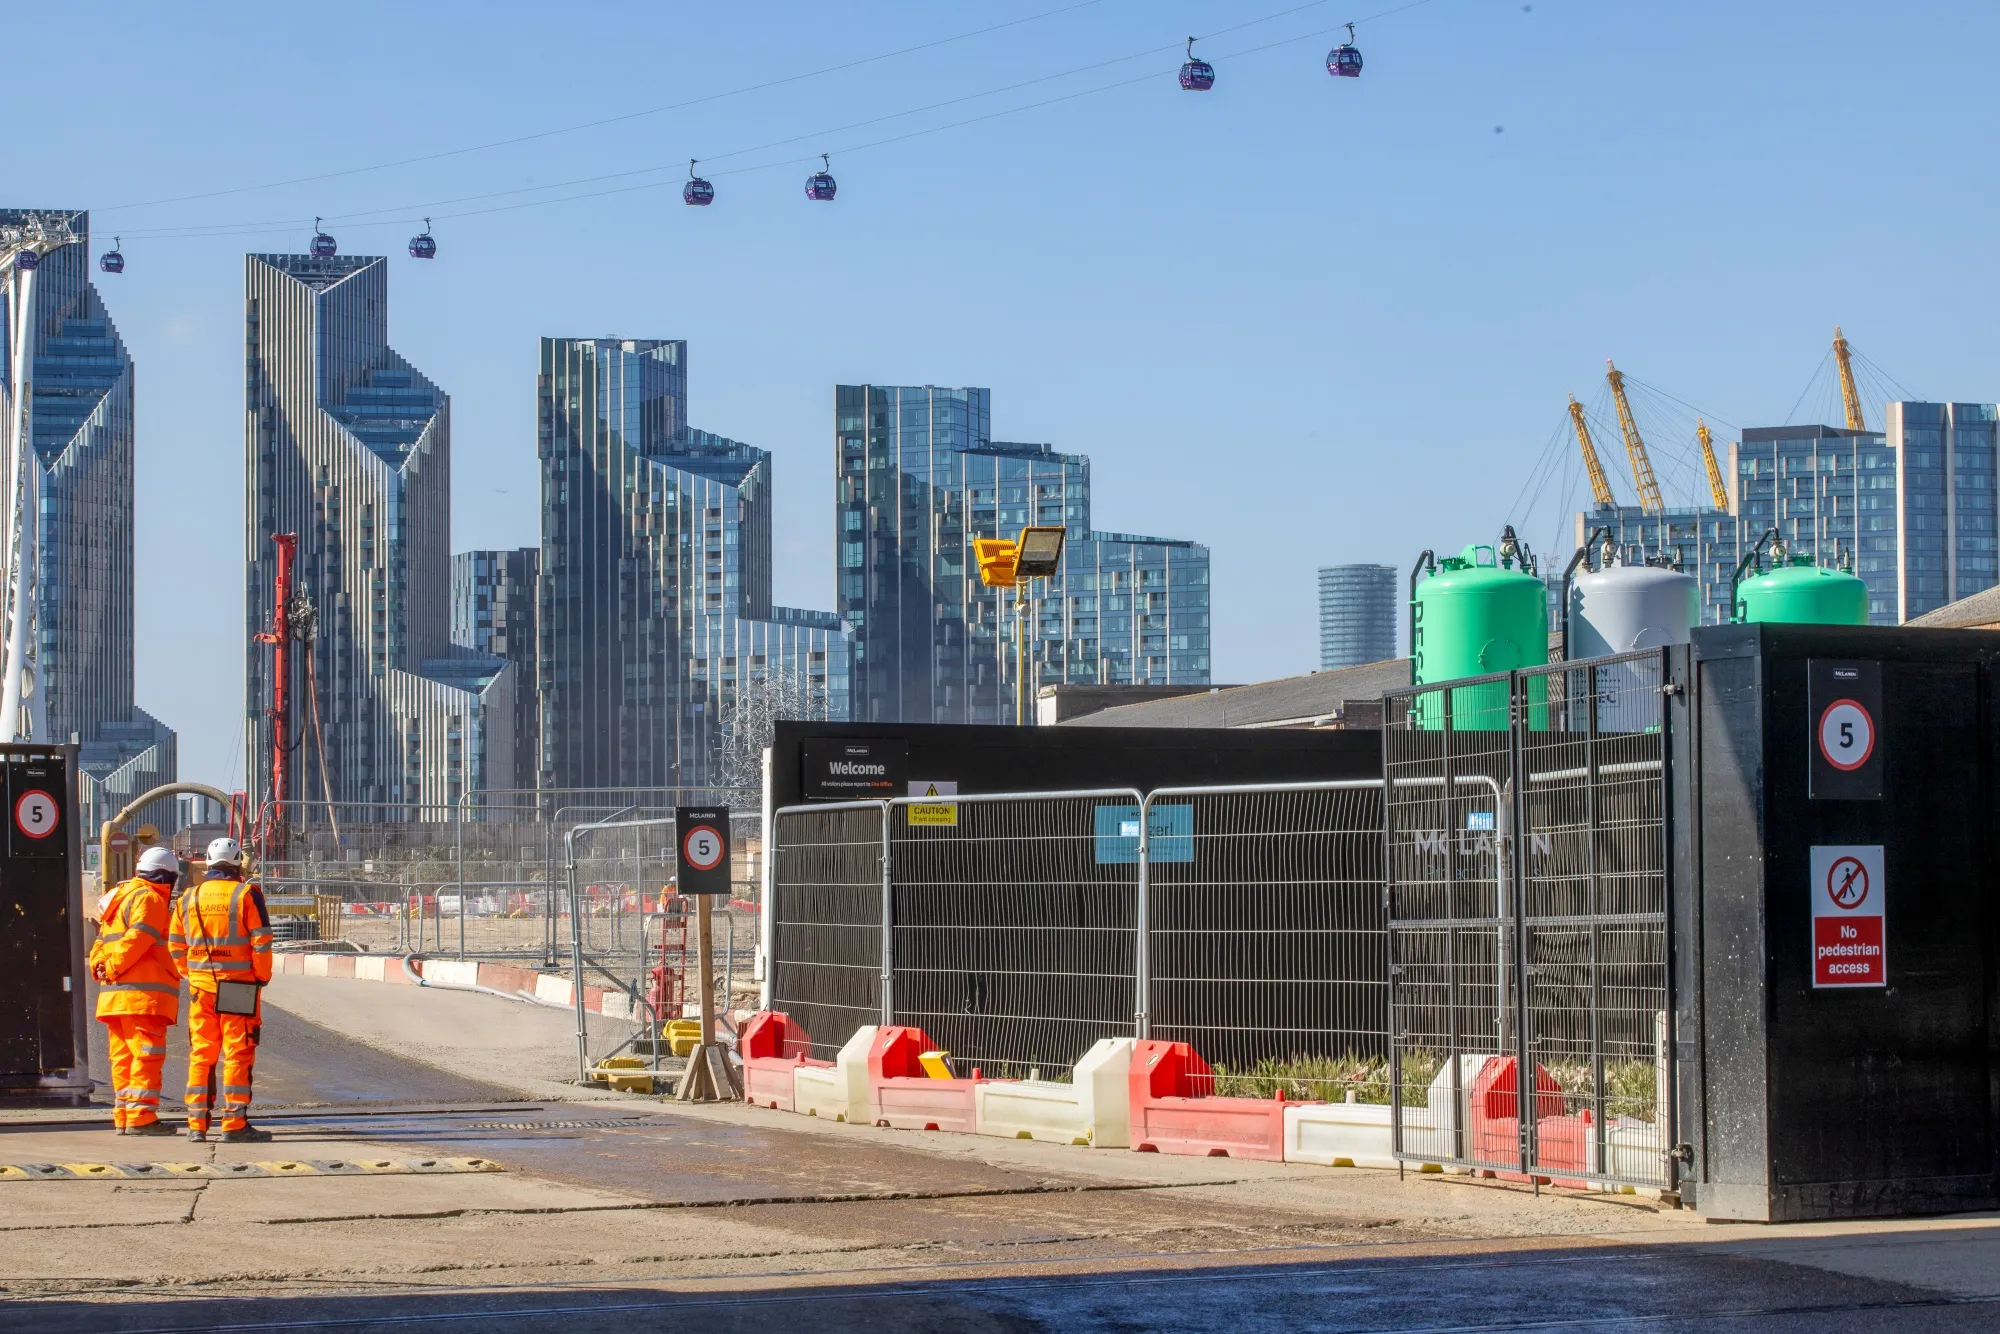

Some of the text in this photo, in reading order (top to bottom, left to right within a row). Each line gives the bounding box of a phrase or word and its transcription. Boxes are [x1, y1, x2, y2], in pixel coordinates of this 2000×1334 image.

[1839, 722, 1854, 749] 5
[829, 762, 885, 775] Welcome
[31, 806, 43, 823] 5
[698, 840, 710, 855] 5
[1840, 925, 1857, 938] No
[1818, 943, 1880, 960] pedestrian
[1828, 963, 1870, 974] access
